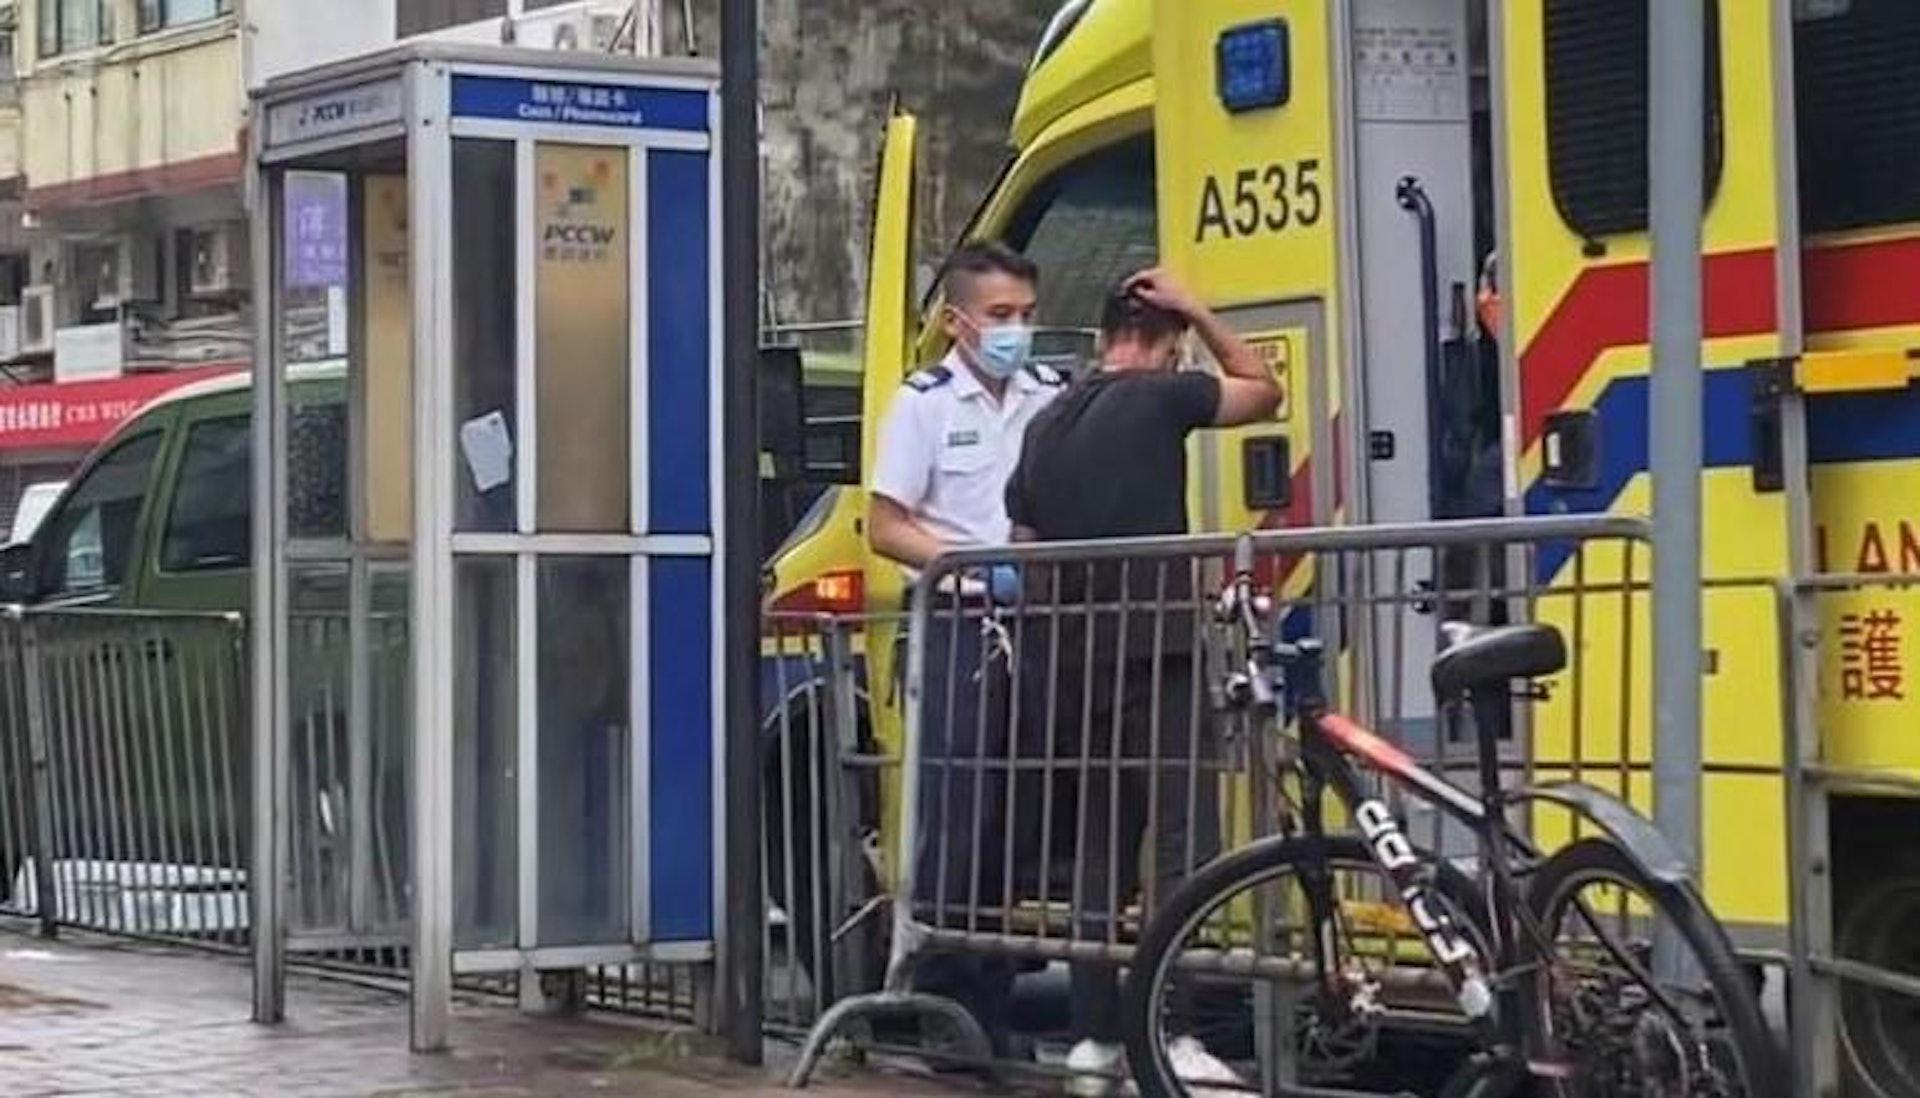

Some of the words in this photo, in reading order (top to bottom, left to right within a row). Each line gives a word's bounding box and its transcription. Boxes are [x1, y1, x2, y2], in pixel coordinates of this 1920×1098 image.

[544, 223, 616, 243] PCCW
[1195, 159, 1323, 243] A535
[1837, 610, 1904, 701] 護
